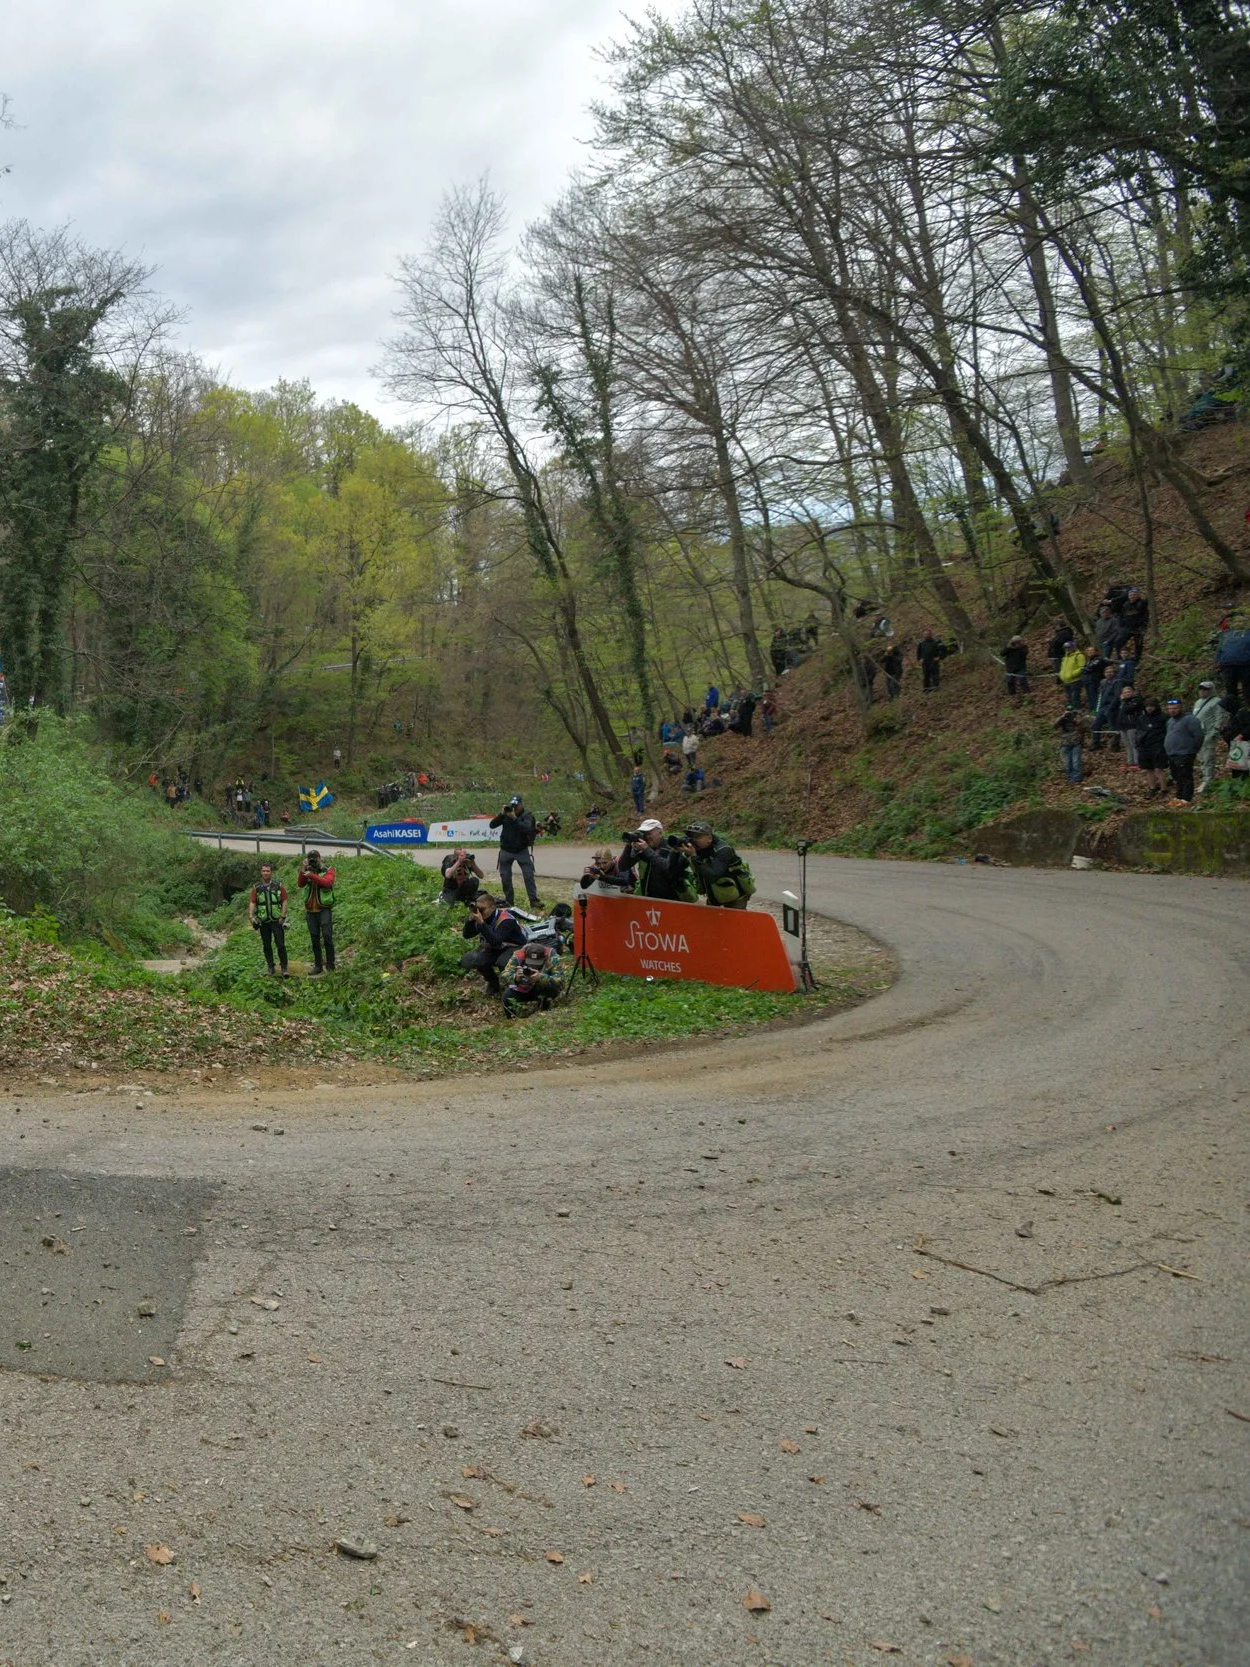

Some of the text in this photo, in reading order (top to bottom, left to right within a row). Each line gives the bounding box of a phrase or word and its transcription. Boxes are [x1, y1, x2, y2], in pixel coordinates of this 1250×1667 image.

[373, 829, 421, 838] AsahiKASEI
[624, 920, 689, 954] STOWA
[640, 959, 682, 974] WATCHES
